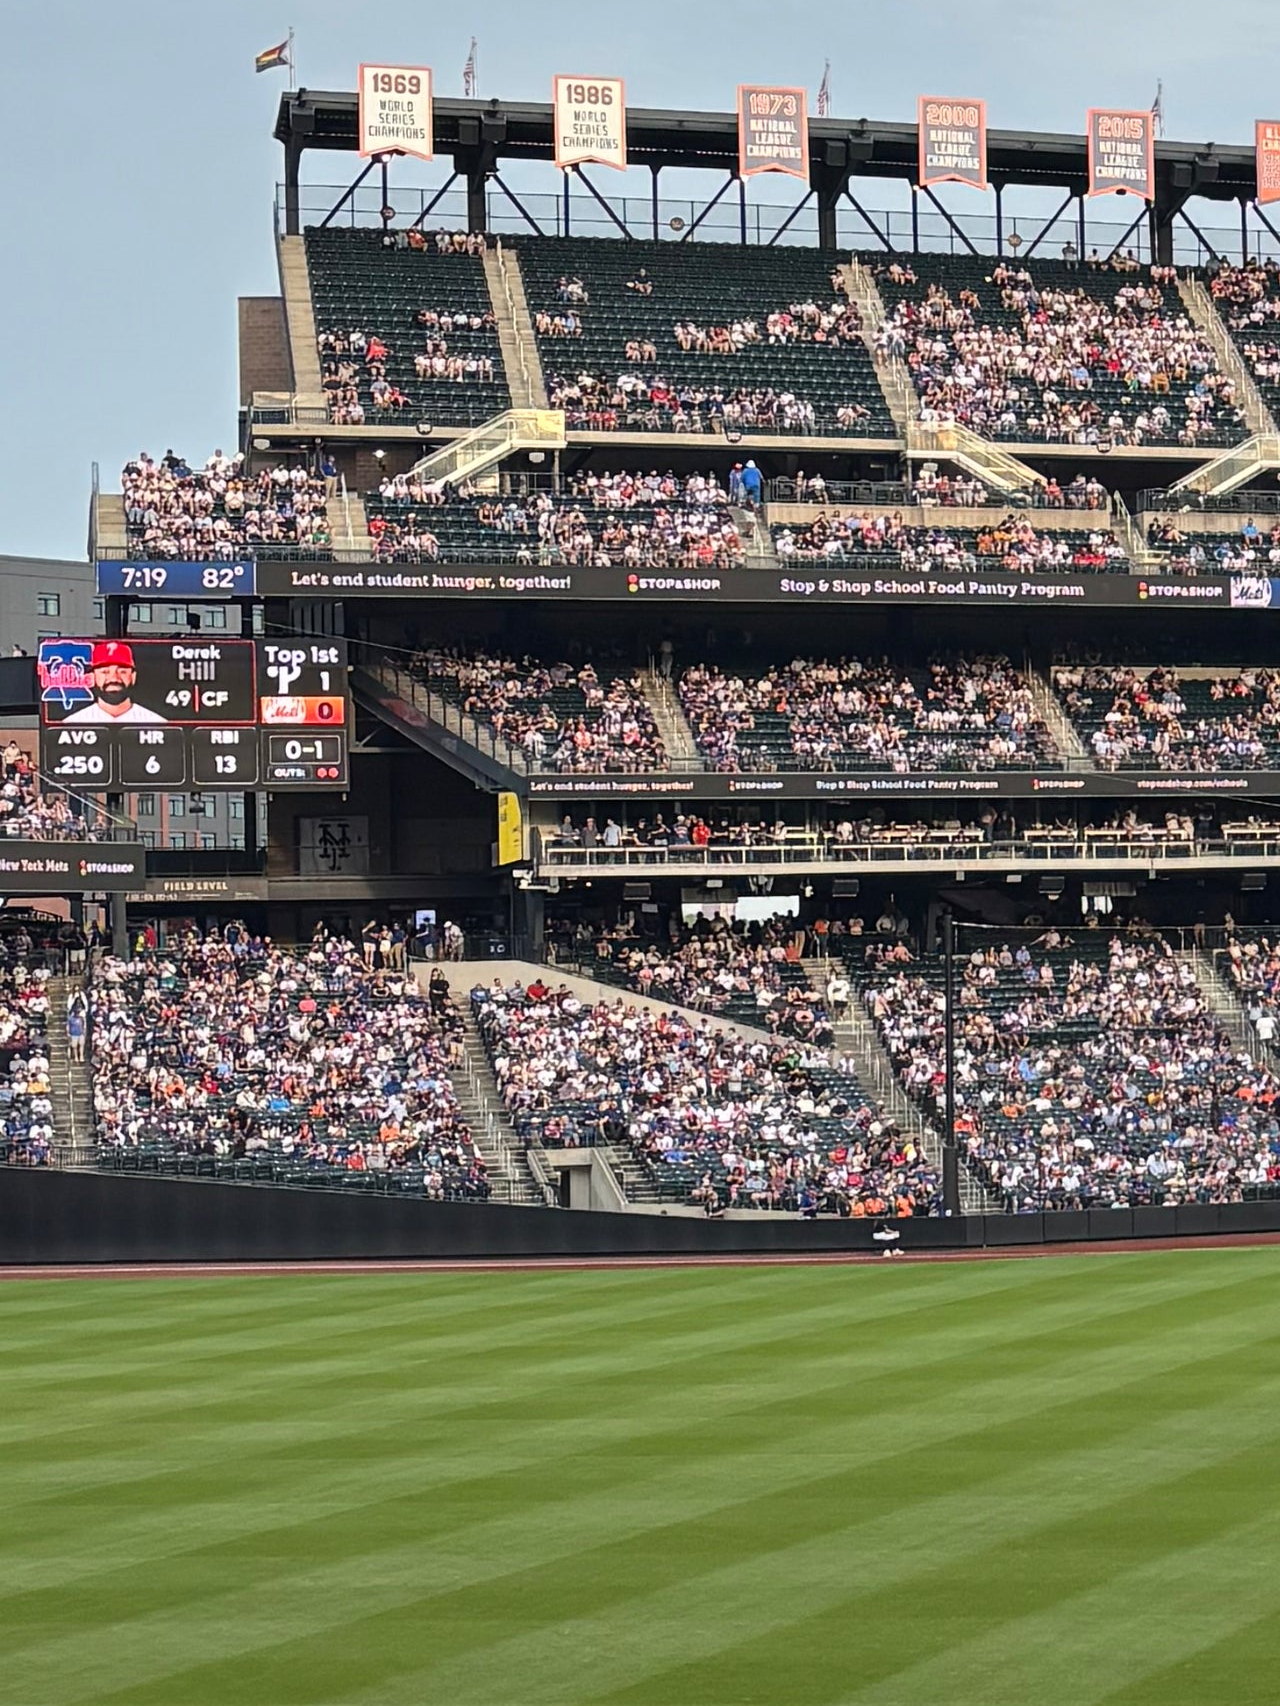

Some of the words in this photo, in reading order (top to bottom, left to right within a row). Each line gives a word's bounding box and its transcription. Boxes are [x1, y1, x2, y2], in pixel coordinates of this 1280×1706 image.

[373, 73, 421, 94] 1969
[566, 83, 613, 105] 1986
[379, 100, 414, 112] WORLD
[749, 93, 797, 116] 1973
[379, 113, 416, 126] SERIES
[574, 110, 607, 122] WORLD
[926, 104, 979, 127] 2000
[368, 125, 426, 139] CHAMPIONS
[573, 124, 608, 136] SERIES
[750, 119, 798, 134] NATIONAL
[1099, 116, 1143, 139] 2015
[563, 136, 619, 149] CHAMPIONS
[755, 133, 793, 145] LEAGUE
[930, 130, 976, 144] NATIONAL
[747, 145, 802, 159] CHAMPIONS
[935, 143, 971, 156] LEAGUE
[927, 154, 980, 170] CHAMPIONS
[121, 567, 167, 588] 7:19
[291, 571, 329, 586] Let's
[333, 572, 363, 587] end
[367, 573, 429, 588] student
[432, 574, 496, 591] hunger,
[498, 575, 571, 592] together!
[780, 578, 816, 595] Stop
[818, 580, 829, 592] &
[832, 580, 871, 596] Shop
[874, 580, 925, 594] School
[928, 581, 965, 594] Food
[968, 581, 1018, 598] Pantry
[1021, 582, 1085, 598] Program
[171, 644, 221, 660] Derek
[264, 645, 306, 667] Top
[309, 645, 339, 664] 1st
[178, 661, 215, 682] Hill
[319, 671, 330, 692] 1
[317, 701, 333, 720] 0
[57, 731, 98, 745] AVG
[139, 731, 164, 745] HR
[210, 731, 239, 744] RBI
[284, 740, 323, 760] 0-1
[54, 756, 104, 775] .250
[145, 756, 161, 775] 6
[214, 755, 237, 774] 13
[530, 781, 553, 791] Let's
[574, 781, 611, 791] student
[871, 779, 903, 789] School
[904, 779, 927, 789] Food
[928, 779, 958, 791] Pantry
[959, 779, 999, 791] Program
[22, 858, 44, 872] York
[164, 881, 194, 891] FIELD
[196, 881, 229, 891] LEVEL
